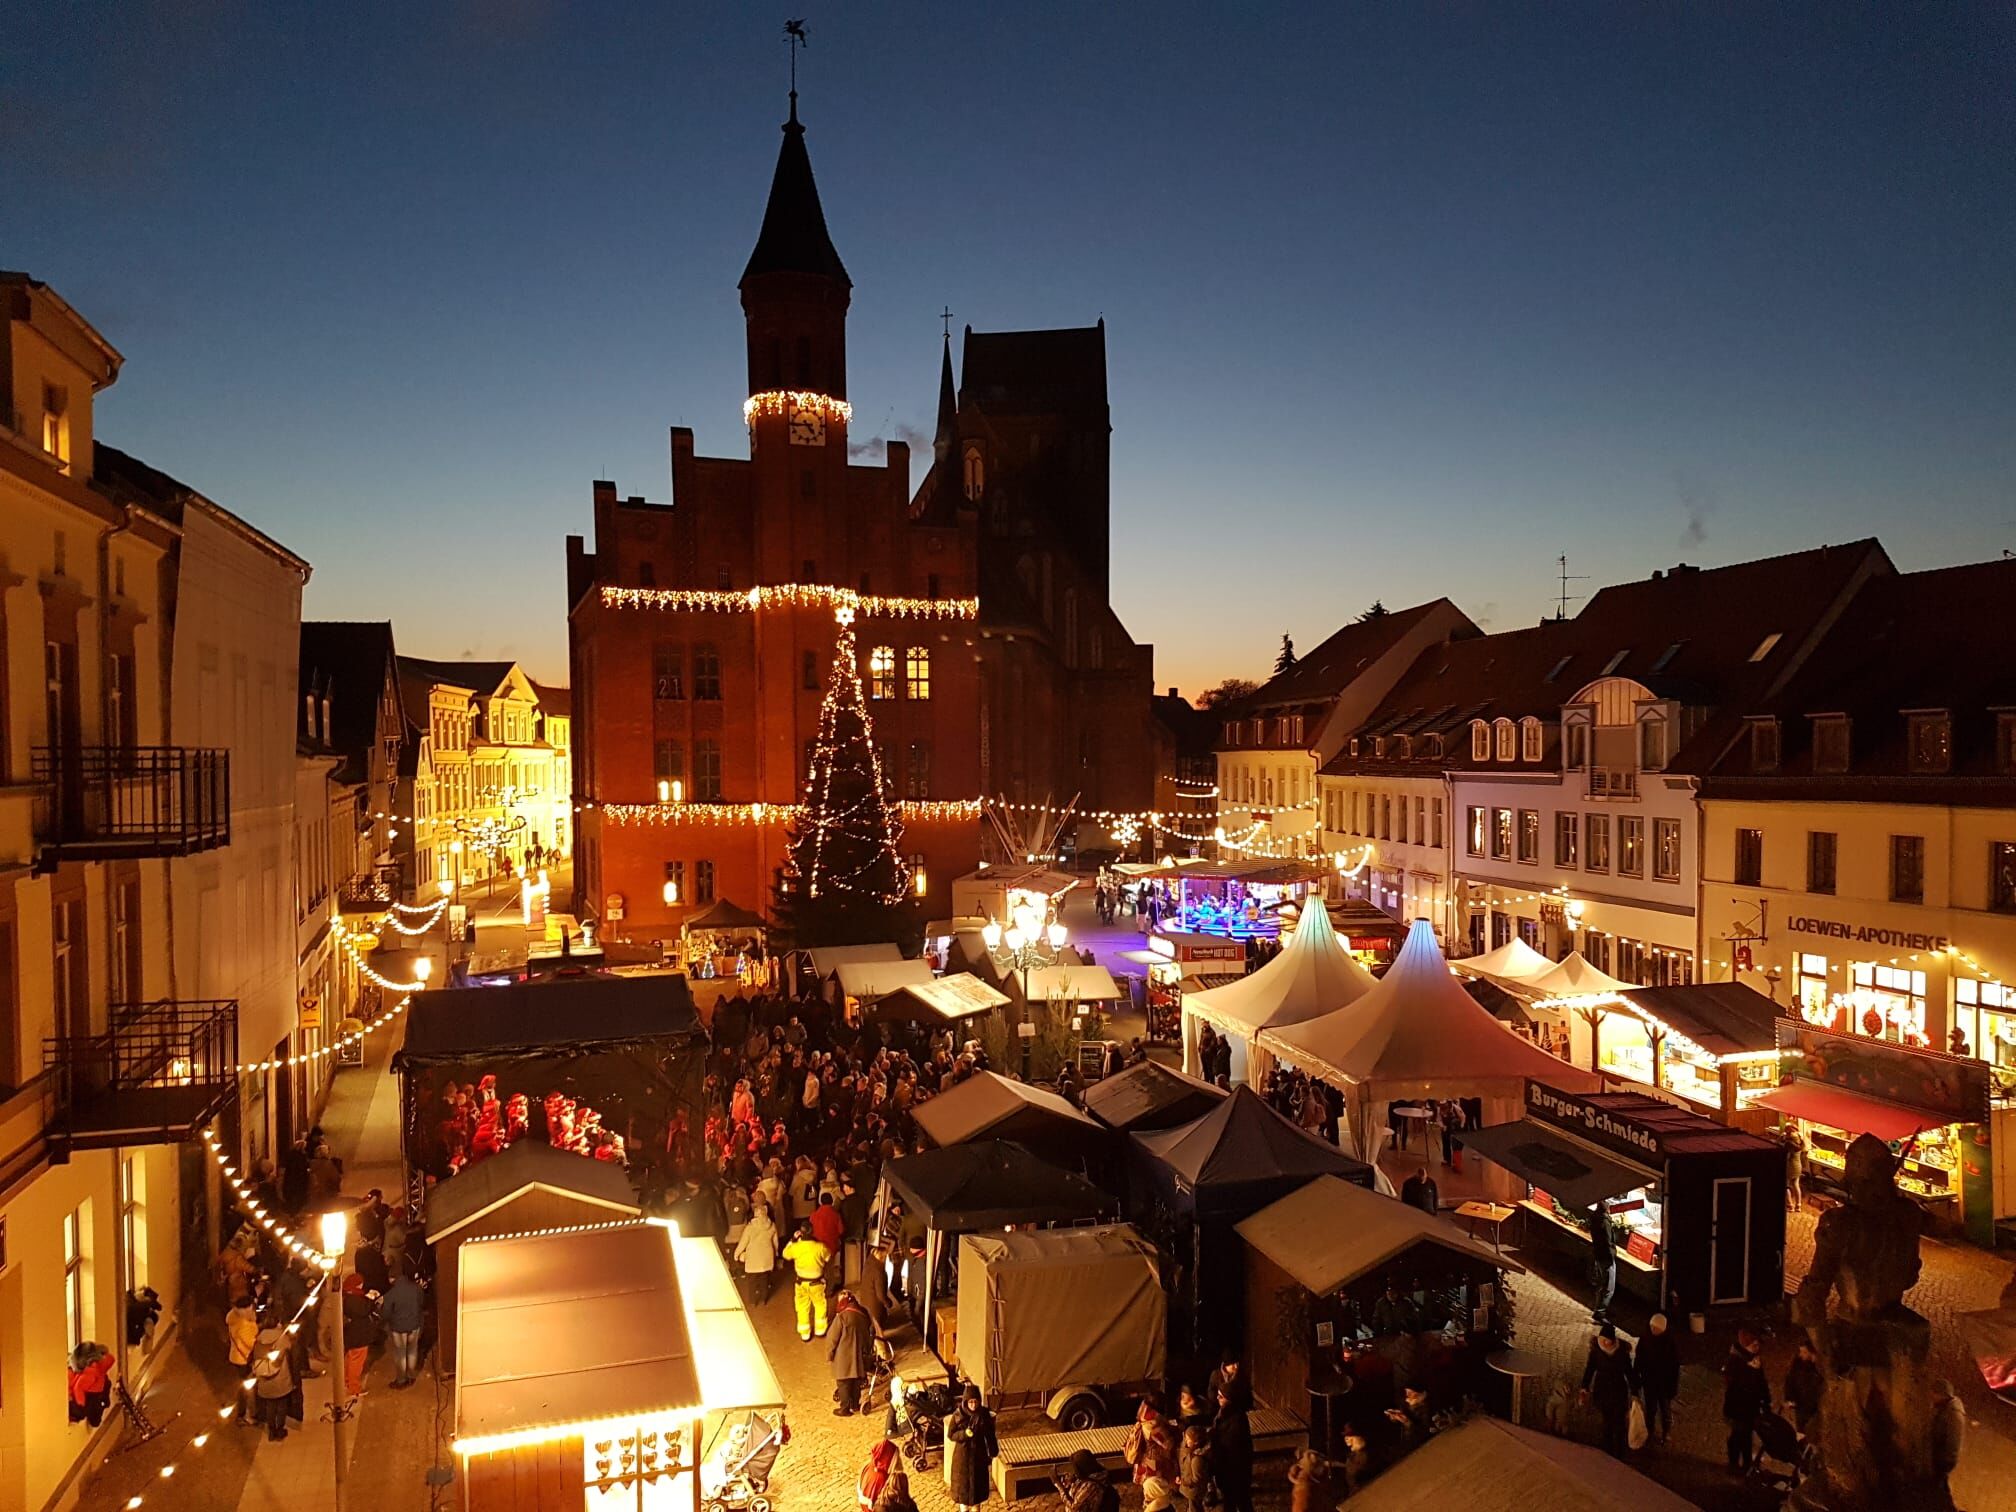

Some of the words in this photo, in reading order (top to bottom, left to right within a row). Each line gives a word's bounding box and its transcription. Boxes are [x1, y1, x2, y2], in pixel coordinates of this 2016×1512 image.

[658, 678, 679, 698] 21
[1787, 915, 1949, 953] LOEWEN-APOTHEKE
[1529, 1083, 1657, 1153] Burger-Schmiede
